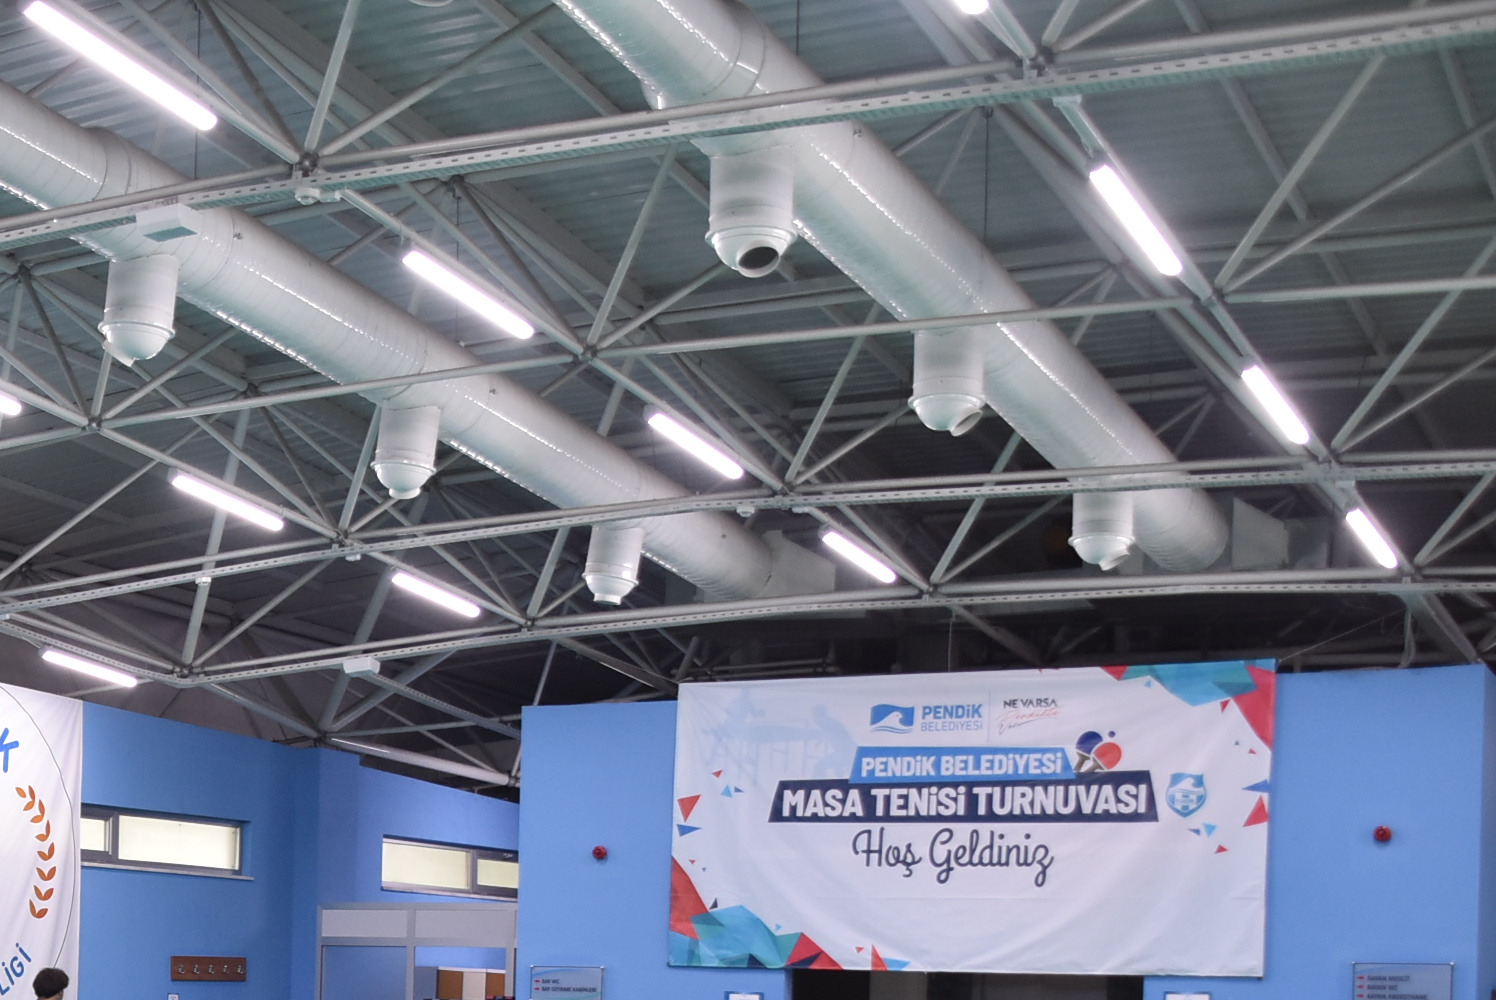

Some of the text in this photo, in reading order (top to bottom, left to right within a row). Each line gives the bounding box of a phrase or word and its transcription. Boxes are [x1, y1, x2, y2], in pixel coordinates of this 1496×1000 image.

[922, 704, 982, 720] PENDİK
[1003, 698, 1058, 709] NE VARSA
[921, 721, 983, 732] BELEDİYESİ
[861, 753, 1062, 777] PENDİK BELEDİYESİ
[782, 784, 1147, 819] MASA TENİSİ TURNUVASI
[852, 829, 1054, 887] Hoş Geldiniz
